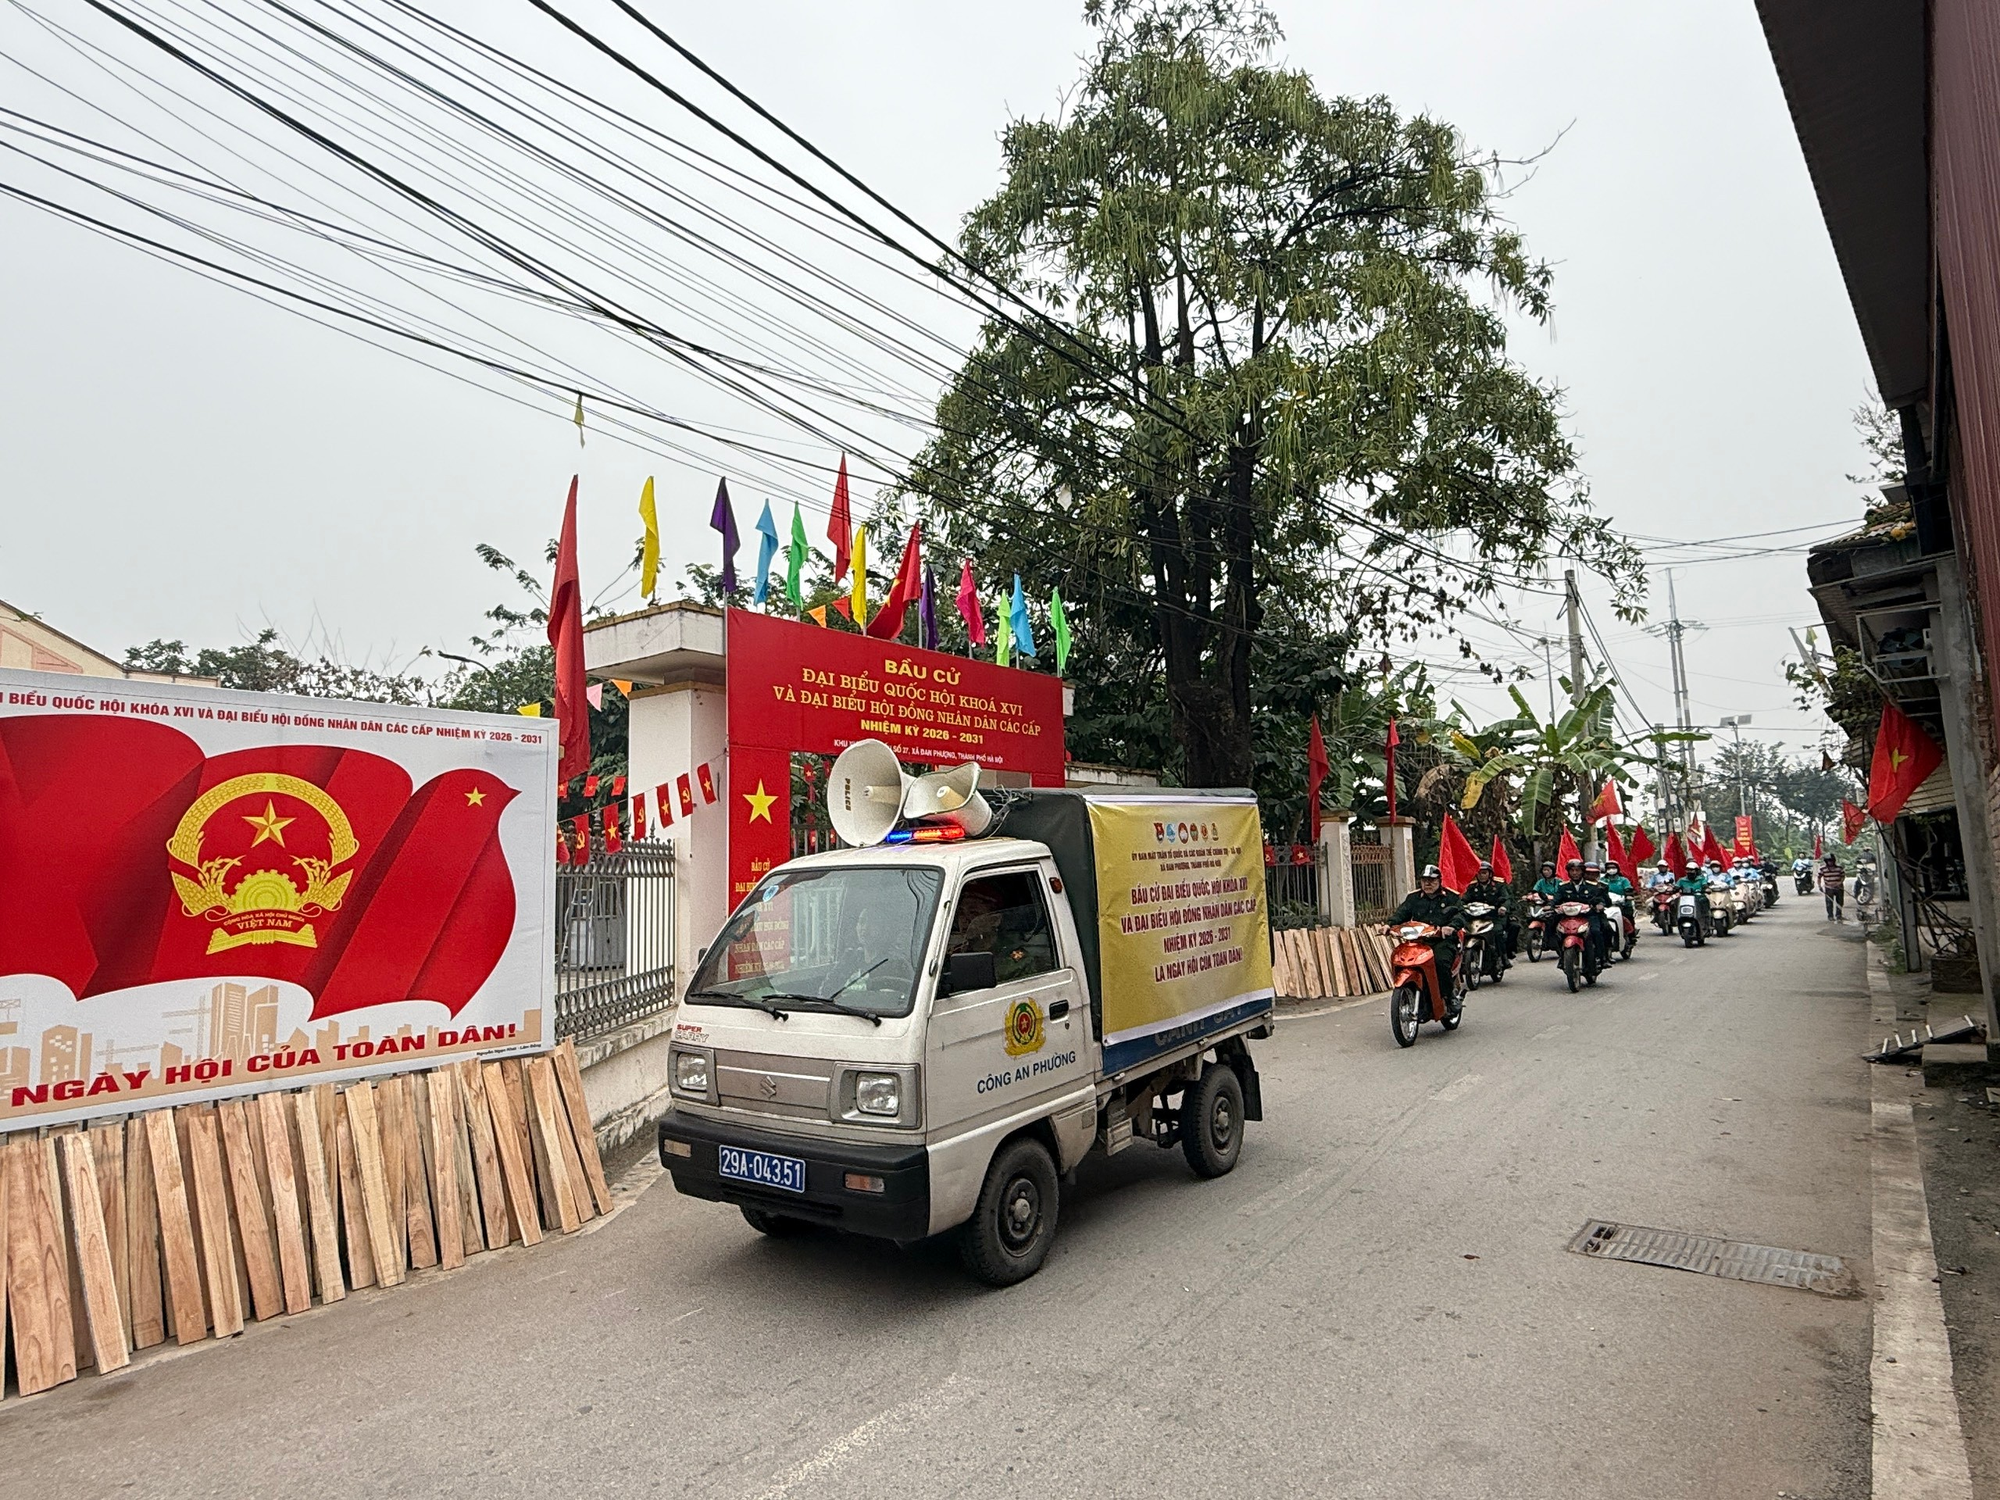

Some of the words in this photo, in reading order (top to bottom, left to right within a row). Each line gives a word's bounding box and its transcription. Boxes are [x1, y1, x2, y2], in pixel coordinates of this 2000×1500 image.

[885, 658, 927, 679] BẦU
[933, 667, 961, 685] CỬ
[802, 668, 835, 688] ĐẠI
[840, 670, 879, 693] BIỂU
[884, 681, 926, 701] QUỐC
[930, 689, 956, 707] HỘI
[959, 697, 997, 713] KHOÁ
[1000, 702, 1023, 716] XVI
[9, 690, 47, 706] BIỂU
[52, 695, 95, 710] QUỐC
[100, 699, 125, 714] HỘI
[130, 702, 169, 716] KHÓA
[174, 706, 194, 718] XVI
[198, 707, 214, 720] VÀ
[217, 709, 237, 723] ĐẠI
[241, 709, 268, 723] BIỂU
[272, 713, 290, 727] HỘI
[294, 714, 324, 728] ĐỒNG
[328, 718, 357, 730] NHÂN
[361, 720, 382, 732] DÂN
[386, 722, 408, 734] CÁC
[411, 723, 433, 736] CẤP
[436, 727, 471, 740] NHIỆM
[473, 728, 486, 739] KỲ
[489, 732, 512, 742] 2026
[521, 734, 542, 744] 2031
[773, 684, 796, 702] VÀ
[800, 689, 828, 709] ĐẠI
[832, 690, 866, 712] BIỂU
[870, 698, 895, 718] HỘI
[898, 700, 934, 722] ĐỒNG
[937, 711, 971, 727] NHÂN
[974, 715, 997, 730] DÂN
[1000, 718, 1020, 733] CÁC
[1022, 720, 1041, 736] CẤP
[861, 719, 901, 735] NHIỆM
[905, 724, 919, 736] KỲ
[922, 727, 949, 740] 2026
[960, 732, 983, 744] 2031
[1150, 882, 1160, 902] CỬ
[1162, 885, 1174, 903] ĐẠI
[1175, 878, 1190, 899] BIỂU
[1192, 877, 1210, 898] QUỐC
[1211, 877, 1222, 897] HỘI
[1239, 877, 1248, 891] XVI
[237, 919, 264, 930] VIỆT
[267, 918, 293, 928] NAM
[1121, 913, 1134, 933] VÀ
[1135, 916, 1149, 934] ĐẠI
[1151, 906, 1167, 929] BIỂU
[1170, 907, 1181, 928] HỘI
[1163, 933, 1187, 954] NHIỆM
[1199, 930, 1213, 946] 2026
[1218, 926, 1231, 942] 2031
[1167, 959, 1186, 979] NGÀY
[1187, 955, 1198, 976] HỘI
[1199, 951, 1212, 971] CỦA
[675, 1031, 710, 1043] CARRY
[677, 1023, 702, 1033] SUPER
[11, 1070, 152, 1107] NGÀY
[165, 1058, 233, 1085] HỘI
[246, 1045, 321, 1073] CỦA
[333, 1034, 426, 1061] TOÀN
[438, 1023, 516, 1047] DÂN!
[977, 1072, 1011, 1094] CÔNG
[1015, 1065, 1030, 1082] AN
[1033, 1051, 1076, 1076] PHƯỜNG
[722, 1150, 801, 1188] 29A-043.51
